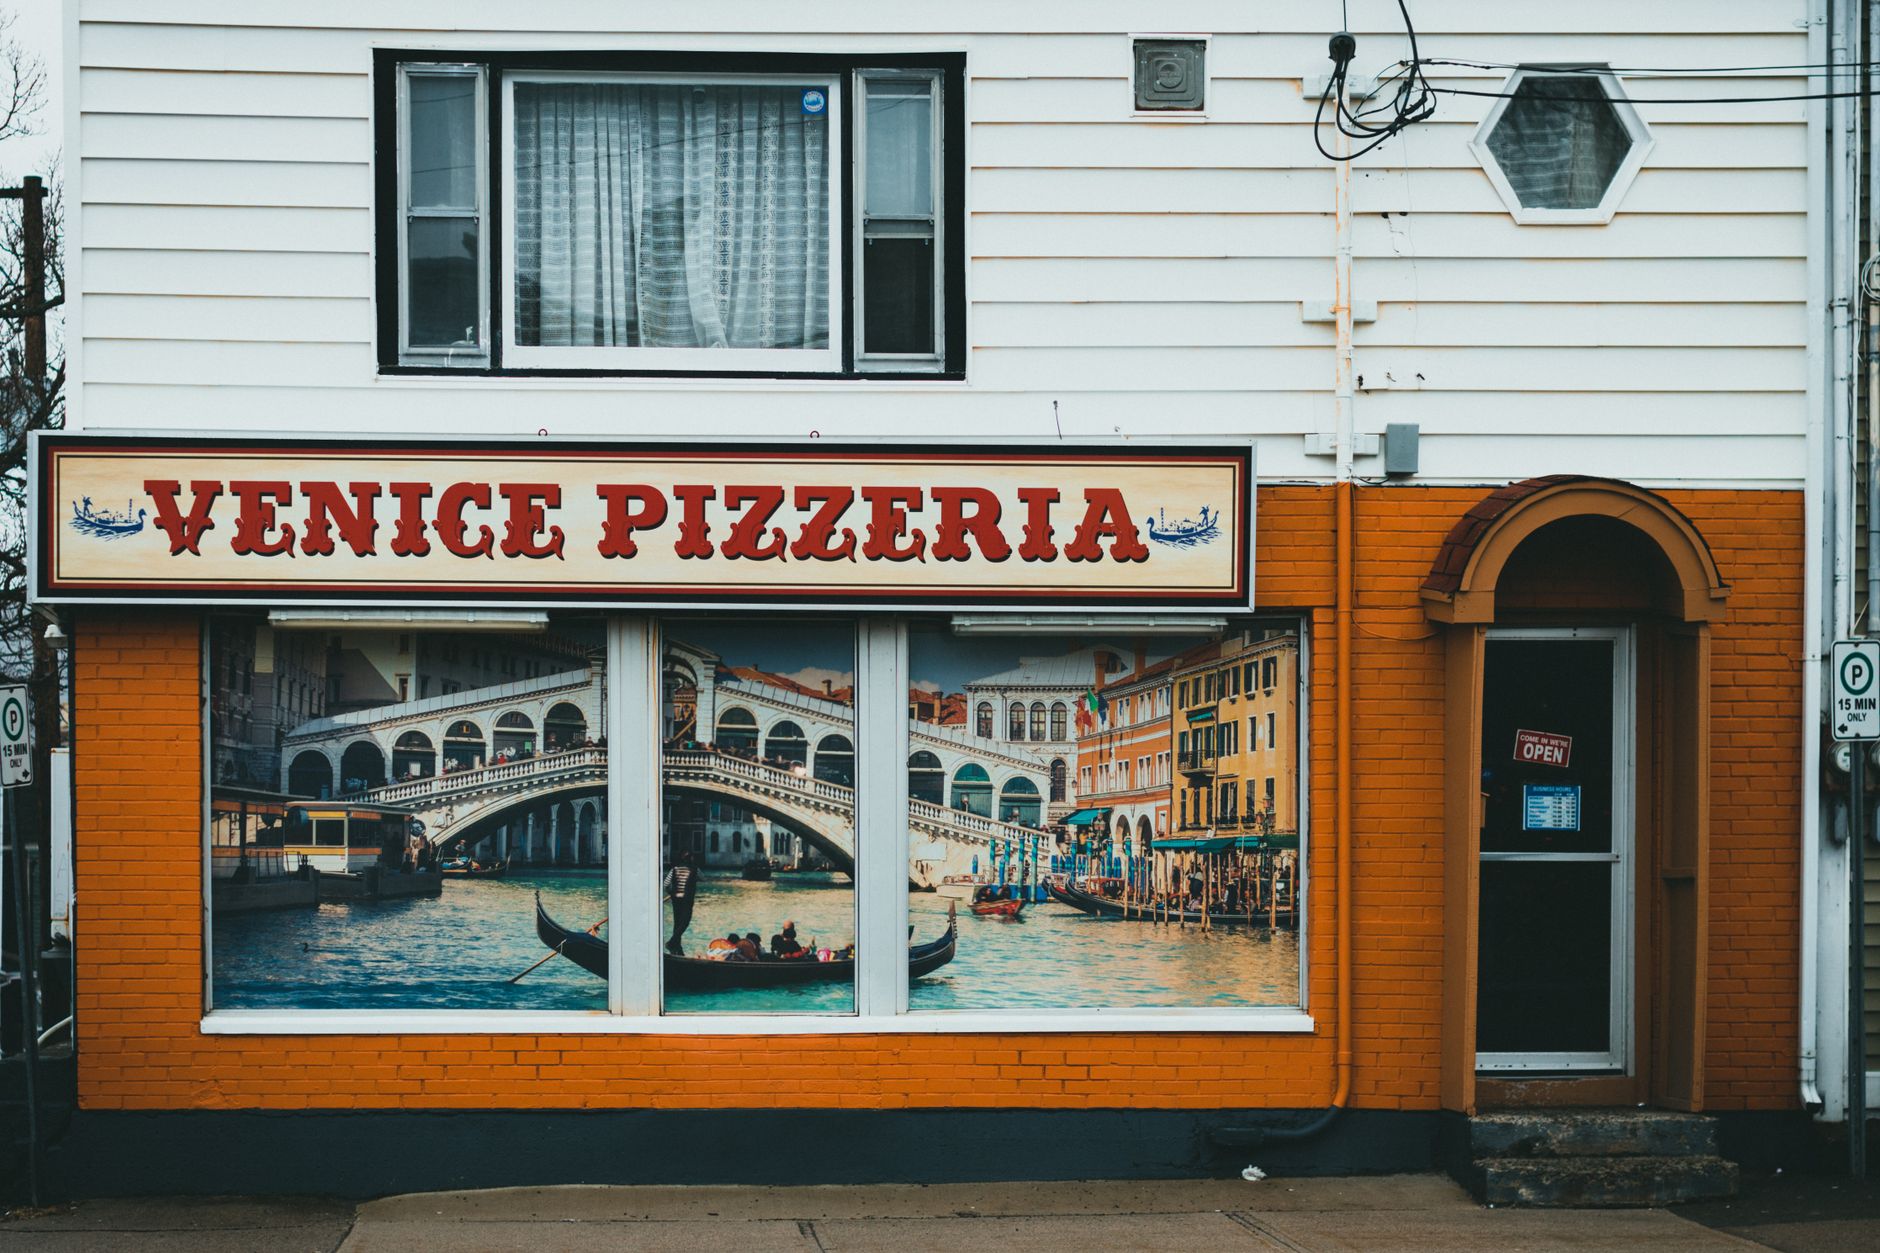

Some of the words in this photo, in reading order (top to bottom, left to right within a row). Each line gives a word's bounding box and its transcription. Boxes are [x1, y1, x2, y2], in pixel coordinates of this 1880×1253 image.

[143, 480, 565, 561] VENICE
[596, 483, 1150, 564] PIZZERIA
[1852, 664, 1863, 686] P
[1838, 698, 1851, 710] 15
[1854, 698, 1876, 710] MIN
[10, 710, 17, 732] P
[1847, 713, 1867, 722] ONLY
[1520, 734, 1540, 743] COME
[1541, 737, 1549, 745] IN
[1549, 738, 1569, 748] WE'RE
[3, 744, 12, 757] 15
[13, 743, 28, 756] MIN
[1523, 742, 1563, 764] OPEN
[9, 758, 22, 768] ONLY
